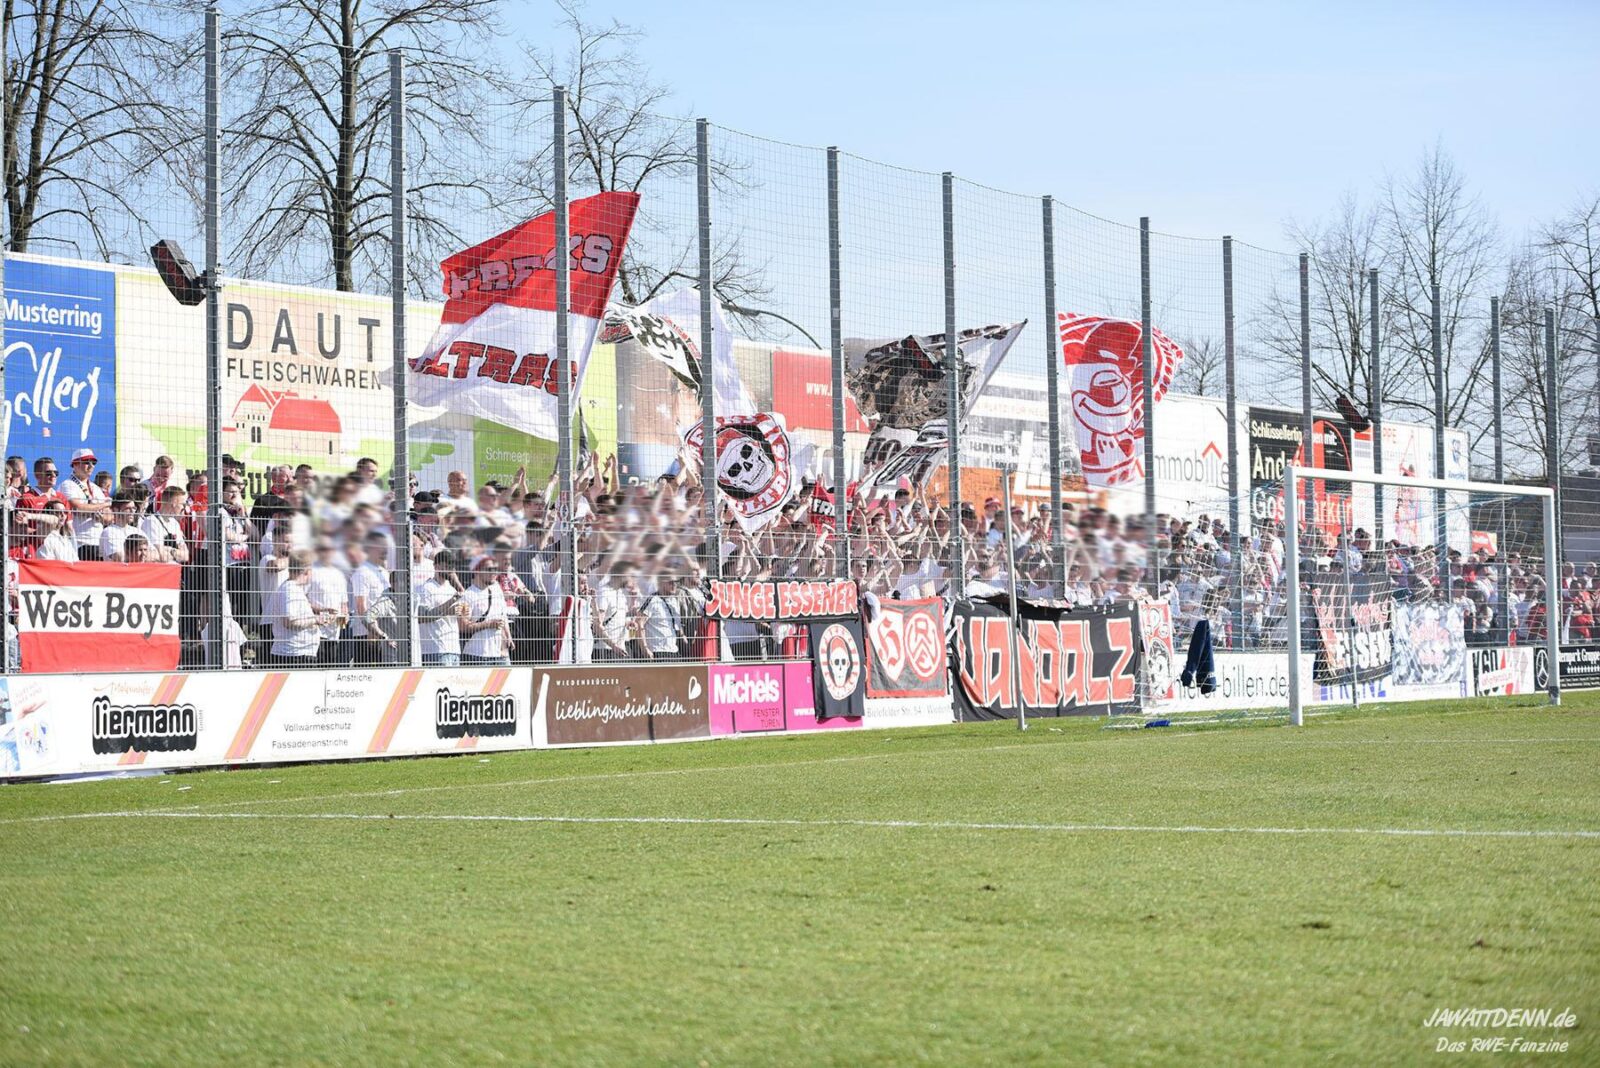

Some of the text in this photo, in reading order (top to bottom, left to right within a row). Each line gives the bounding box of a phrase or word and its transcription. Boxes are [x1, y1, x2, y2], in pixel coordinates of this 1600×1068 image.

[3, 297, 102, 335] Musterring
[226, 303, 381, 363] DAUT
[227, 357, 382, 391] FLEISCHWAREN
[21, 590, 174, 638] West Boys
[705, 578, 859, 619] JUNGE ESSENER
[713, 672, 780, 705] Michels
[753, 707, 780, 718] FENSTER
